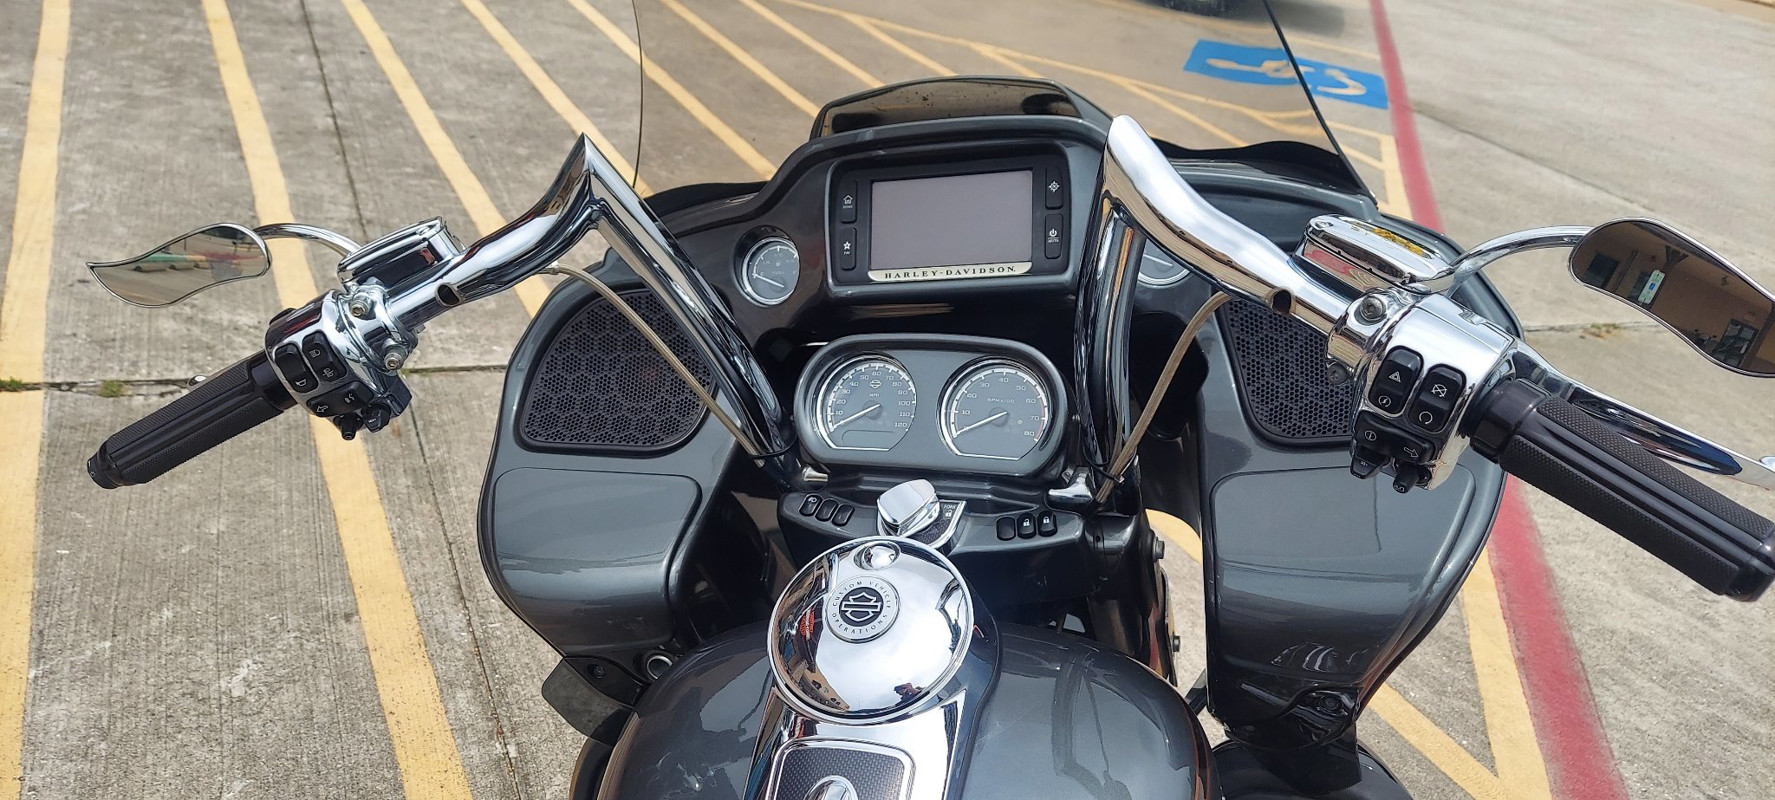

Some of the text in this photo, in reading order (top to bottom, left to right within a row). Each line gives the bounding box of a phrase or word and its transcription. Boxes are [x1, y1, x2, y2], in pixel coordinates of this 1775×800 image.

[833, 581, 891, 608] CUSTOM VEHICLE
[832, 613, 887, 634] OPERATIONS
